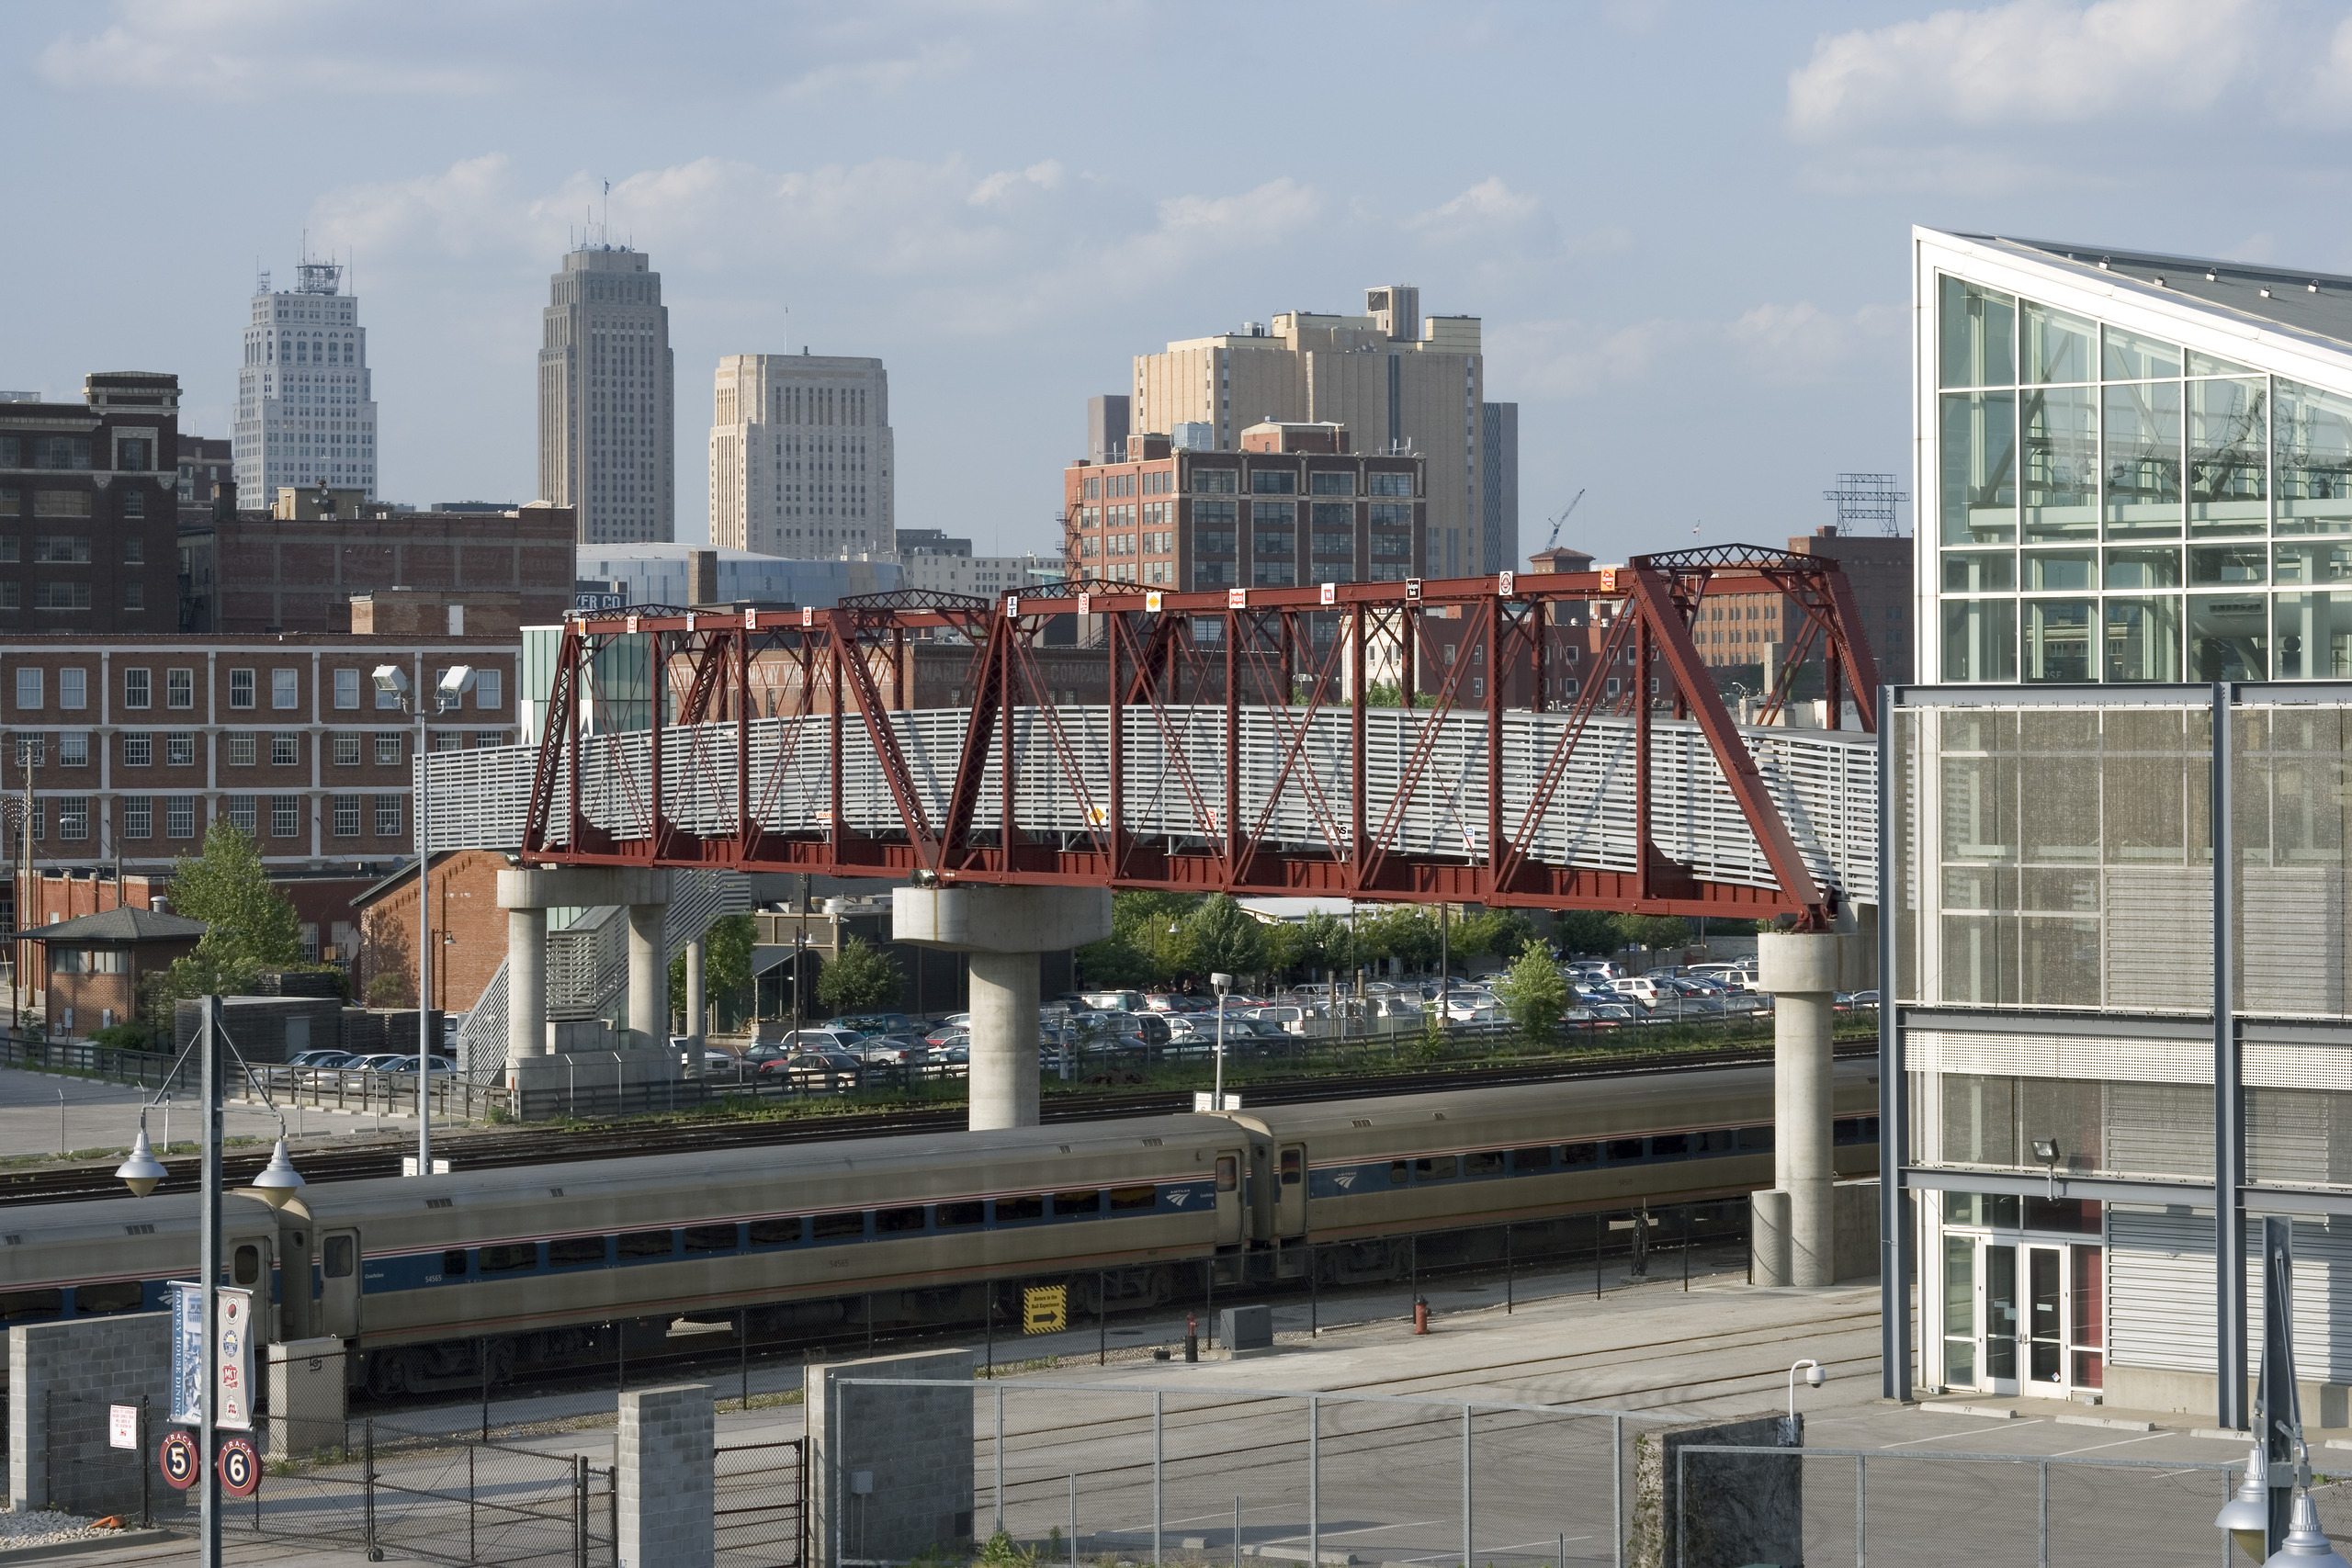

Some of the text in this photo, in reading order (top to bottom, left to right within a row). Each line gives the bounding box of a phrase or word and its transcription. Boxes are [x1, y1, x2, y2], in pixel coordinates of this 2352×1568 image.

[424, 1274, 442, 1283] 54565
[164, 1433, 193, 1449] TRACK
[222, 1440, 252, 1456] TRACK
[171, 1446, 187, 1475] 5
[230, 1453, 245, 1483] 6
